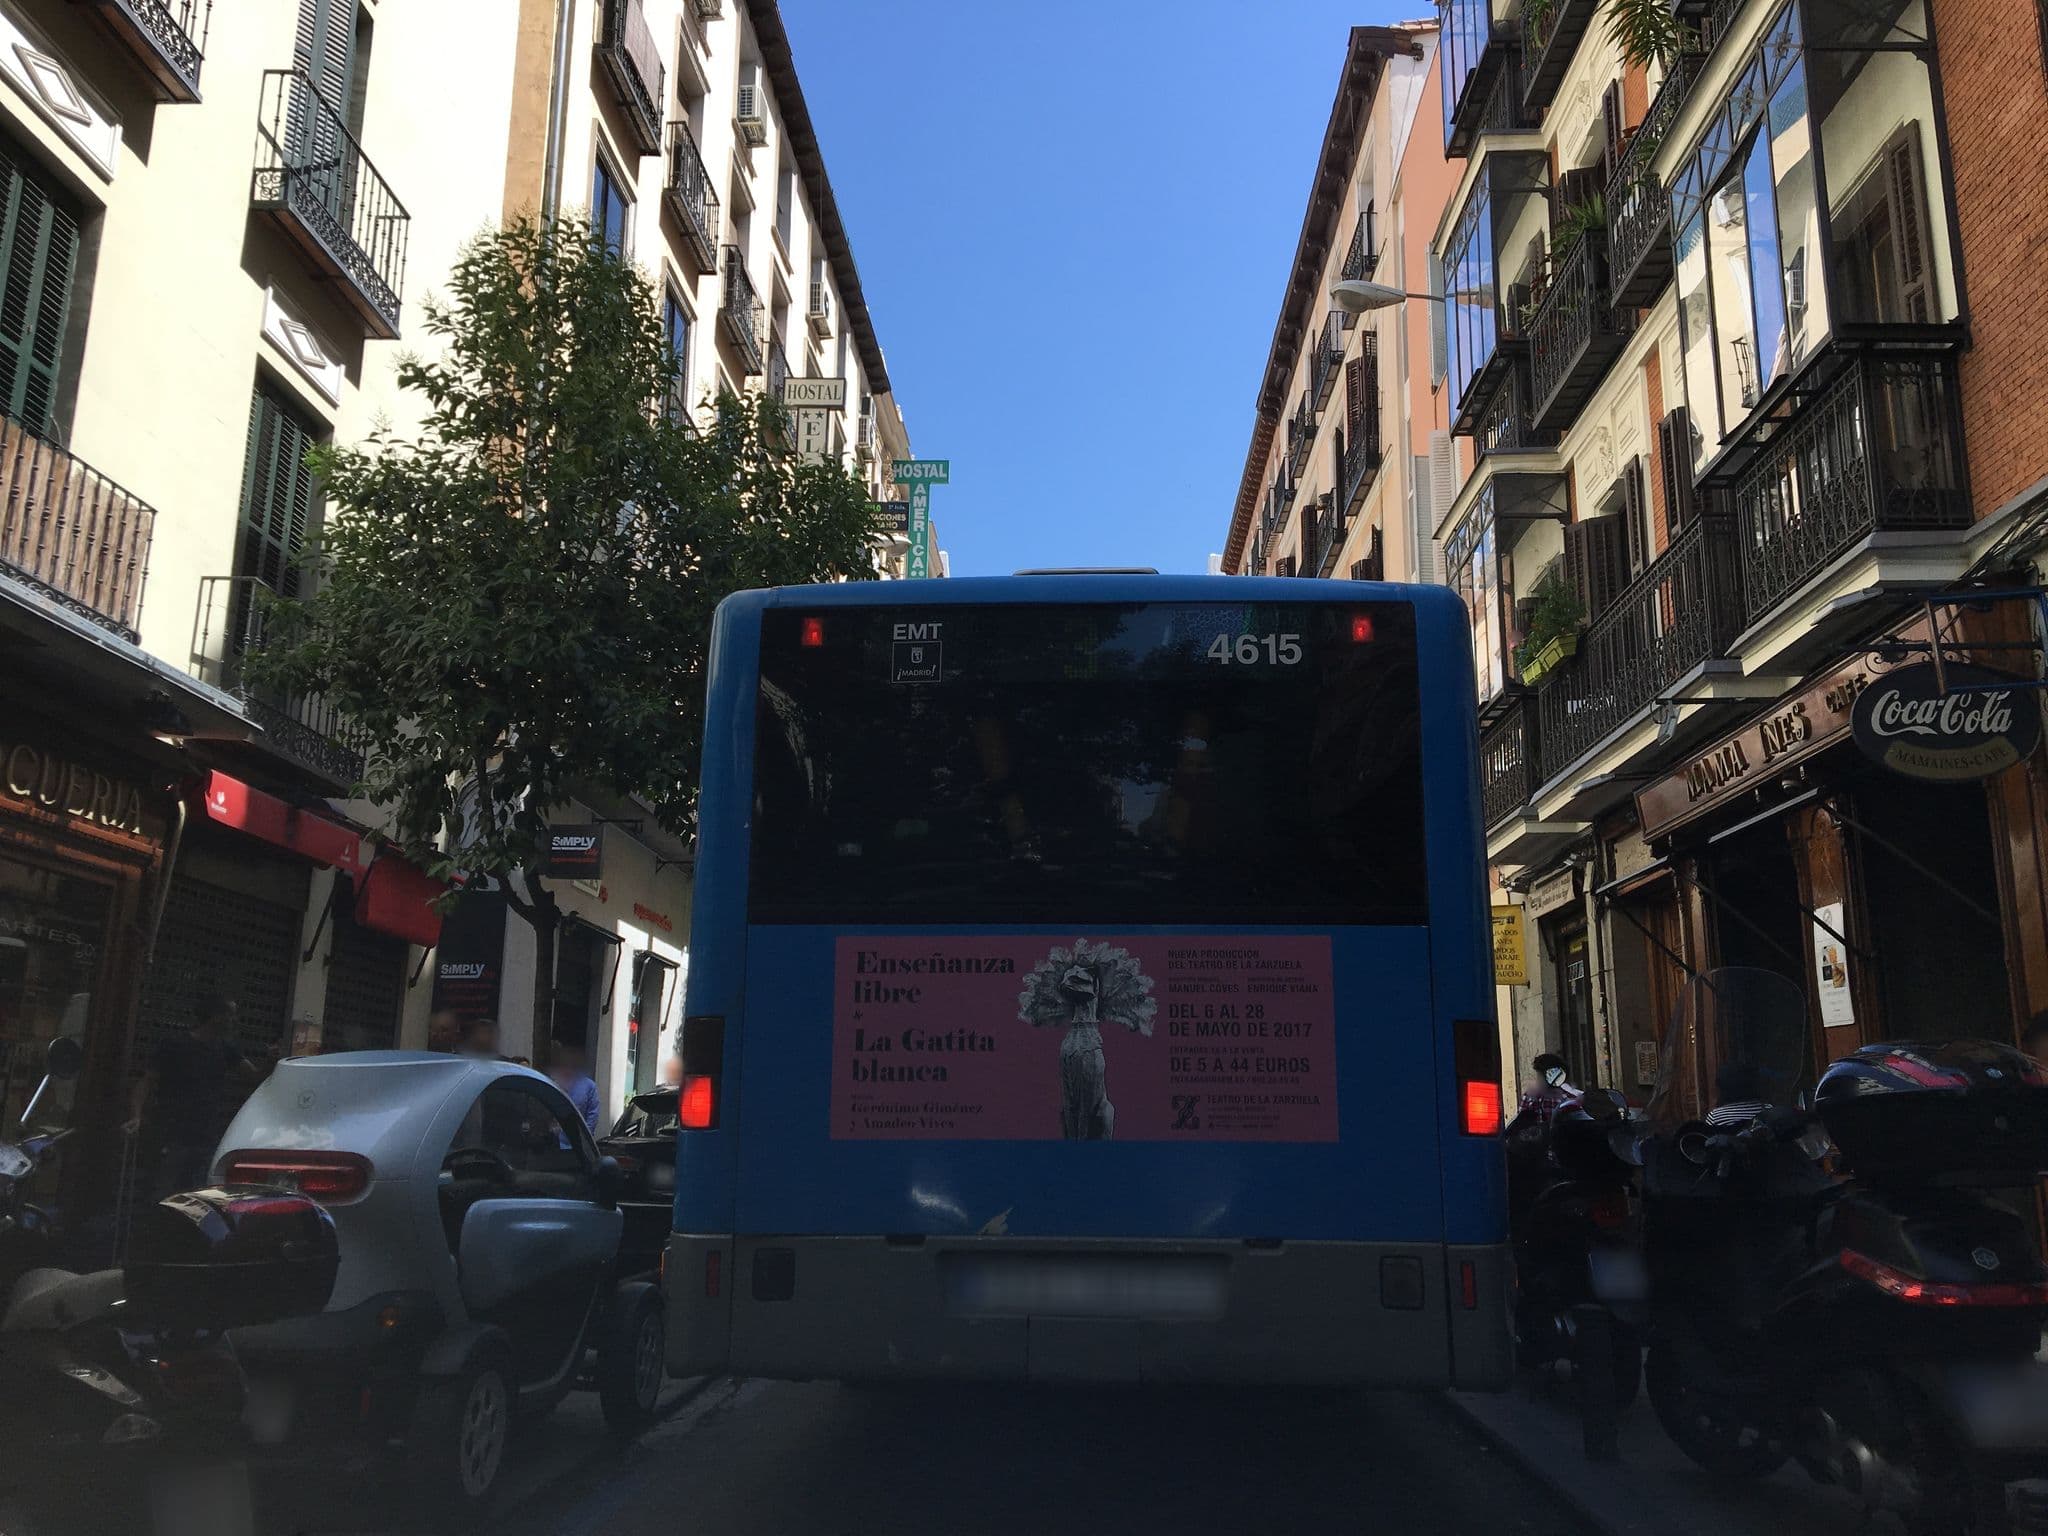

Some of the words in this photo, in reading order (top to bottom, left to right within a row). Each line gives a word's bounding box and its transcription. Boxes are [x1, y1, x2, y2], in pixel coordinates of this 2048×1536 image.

[787, 384, 841, 400] HOSTAL
[893, 463, 947, 478] HOSTAL
[911, 483, 927, 569] AMERICA
[893, 623, 942, 640] EMT
[1207, 634, 1303, 665] 4615
[1870, 689, 2013, 736] Coca-Cola
[857, 951, 1015, 973] Enseñanza
[1168, 960, 1184, 969] DEL
[854, 980, 922, 1003] libre
[1169, 1003, 1200, 1019] DEL
[1204, 1003, 1214, 1019] 6
[1219, 1003, 1240, 1019] AL
[1245, 1003, 1265, 1019] 28
[1169, 1022, 1191, 1037] DE
[1196, 1022, 1241, 1037] MAYO
[1247, 1022, 1269, 1037] DE
[1273, 1023, 1313, 1038] 2017
[855, 1028, 892, 1052] La
[901, 1028, 996, 1052] Gatita
[852, 1058, 948, 1083] blanca
[1170, 1057, 1191, 1073] DE
[1197, 1057, 1208, 1073] 5
[1212, 1057, 1224, 1073] A
[1230, 1057, 1249, 1073] 44
[1255, 1057, 1311, 1073] EUROS
